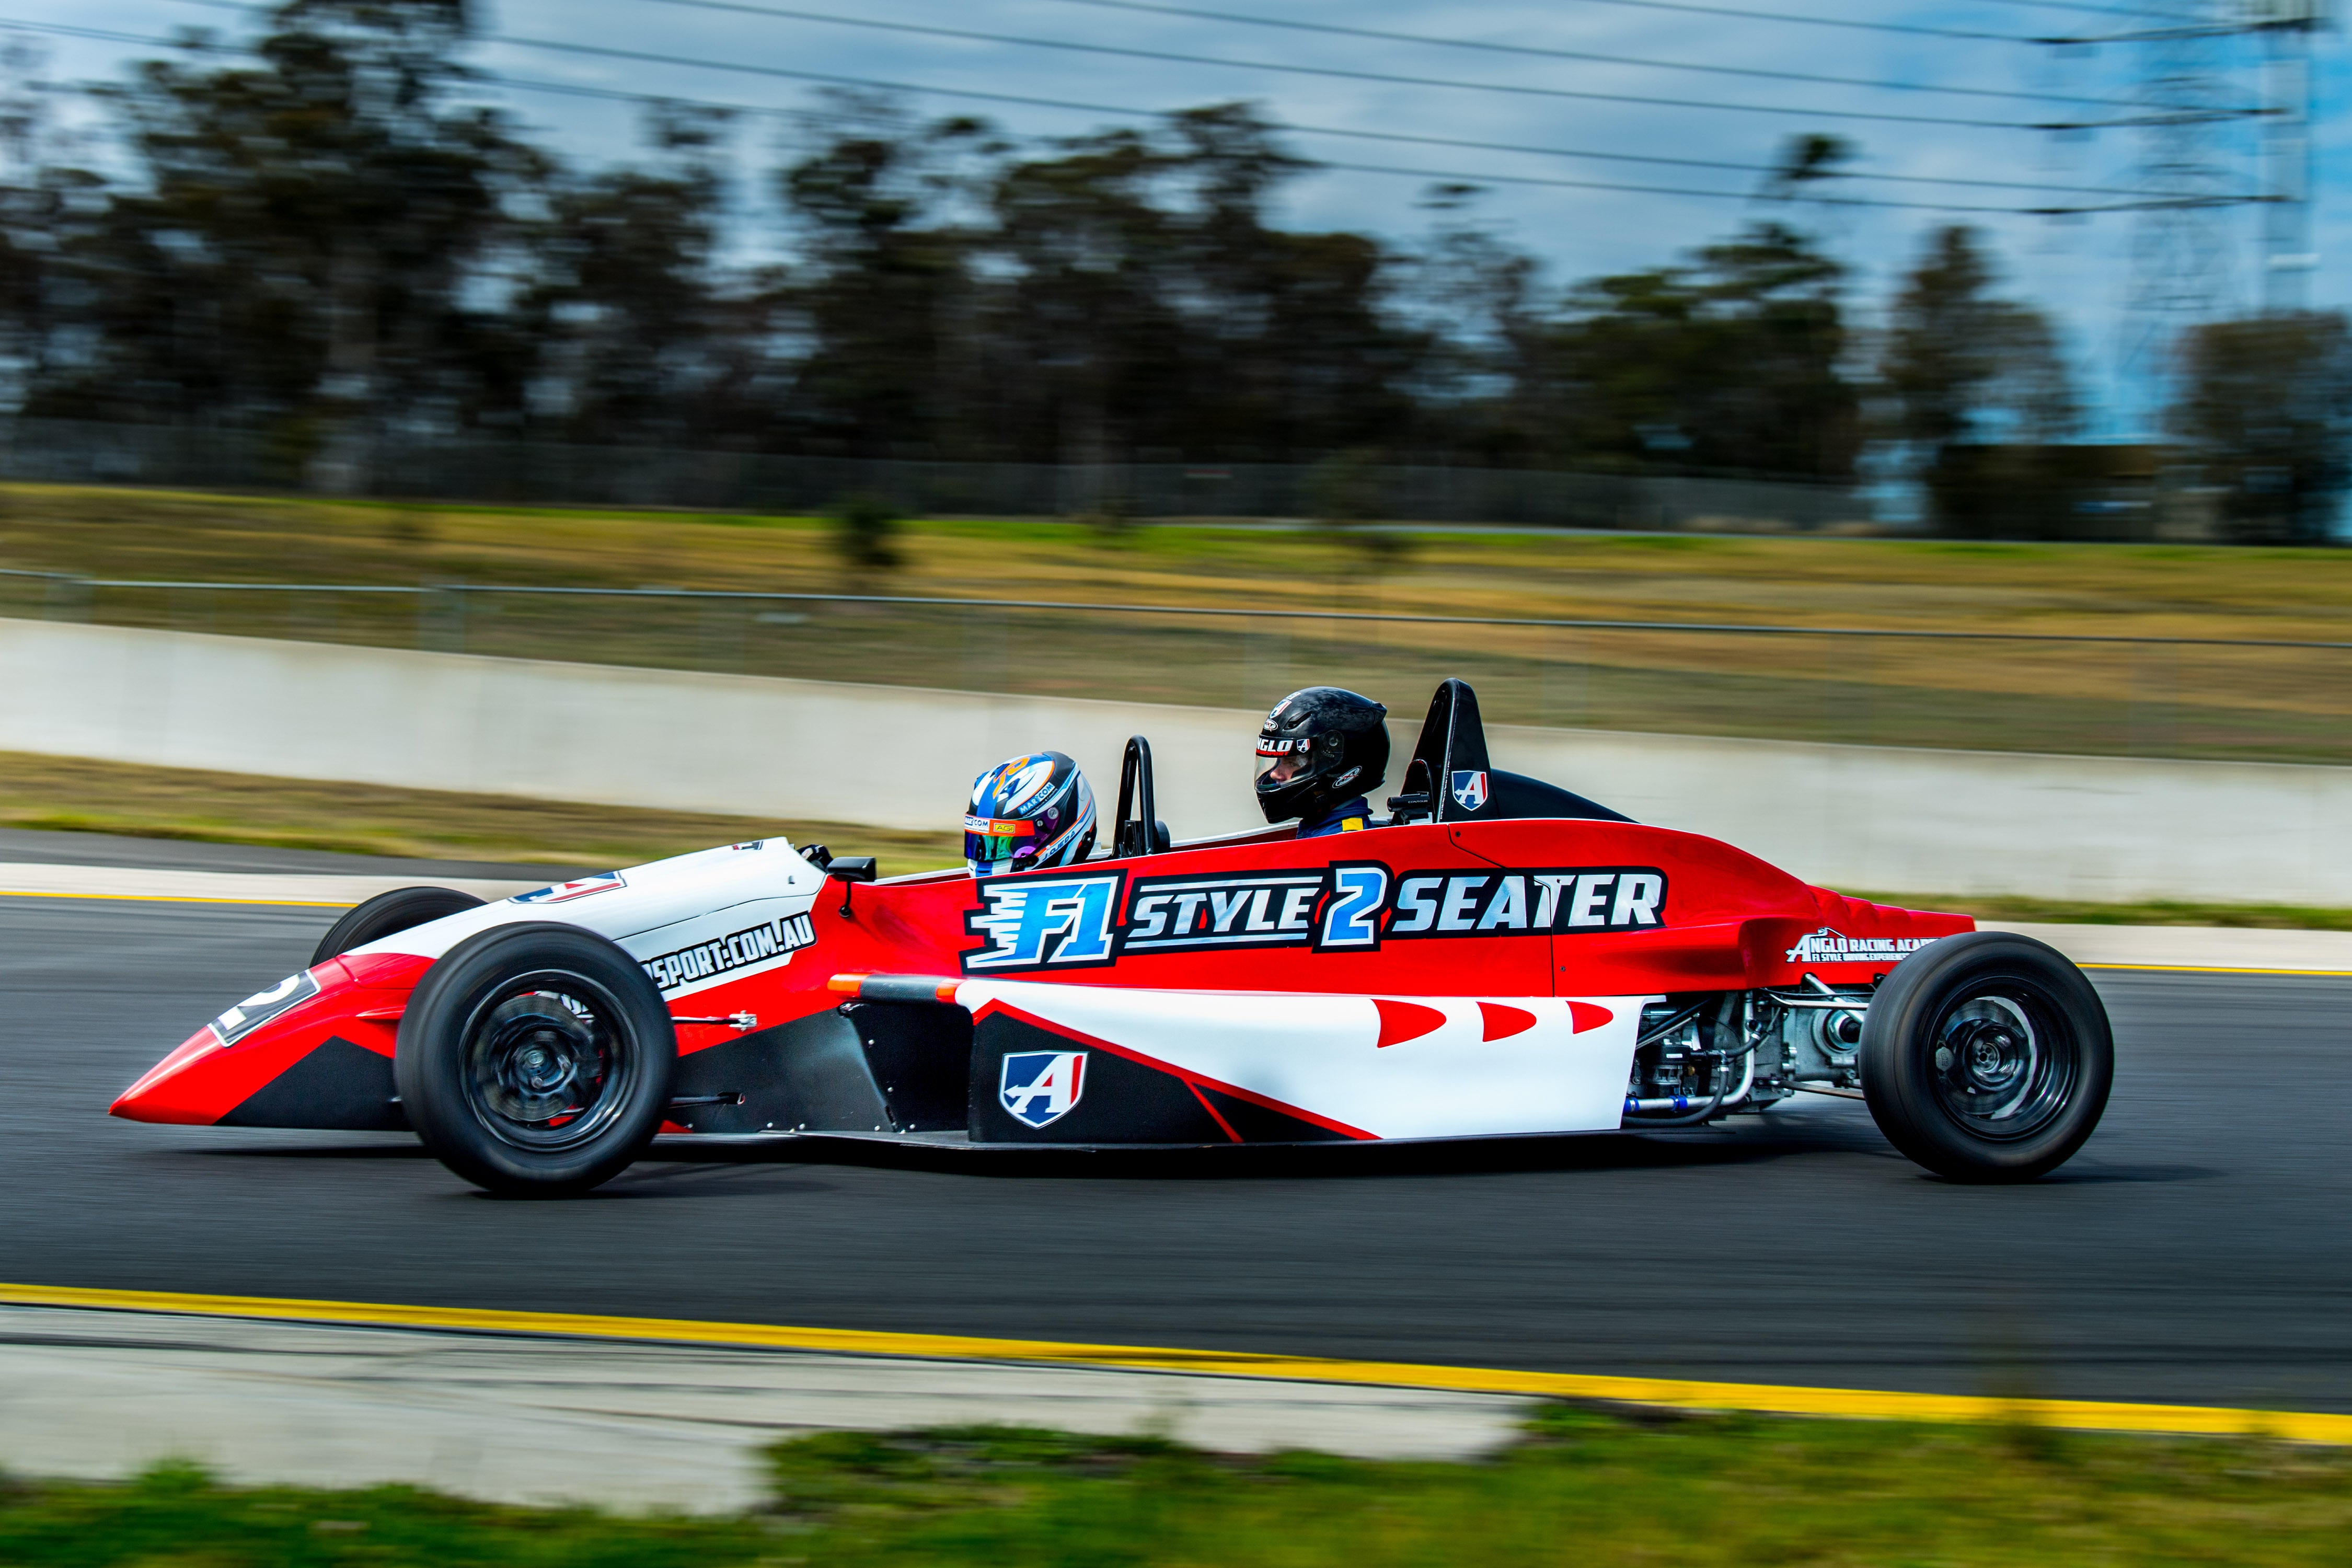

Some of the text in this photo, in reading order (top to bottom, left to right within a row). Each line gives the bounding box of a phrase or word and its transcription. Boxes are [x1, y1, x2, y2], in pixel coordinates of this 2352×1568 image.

[1256, 736, 1294, 752] NGLO
[966, 867, 1663, 969] F1 STYLE 2 SEATER
[1785, 933, 1849, 962] ANGLO
[1849, 939, 1896, 952] RACING
